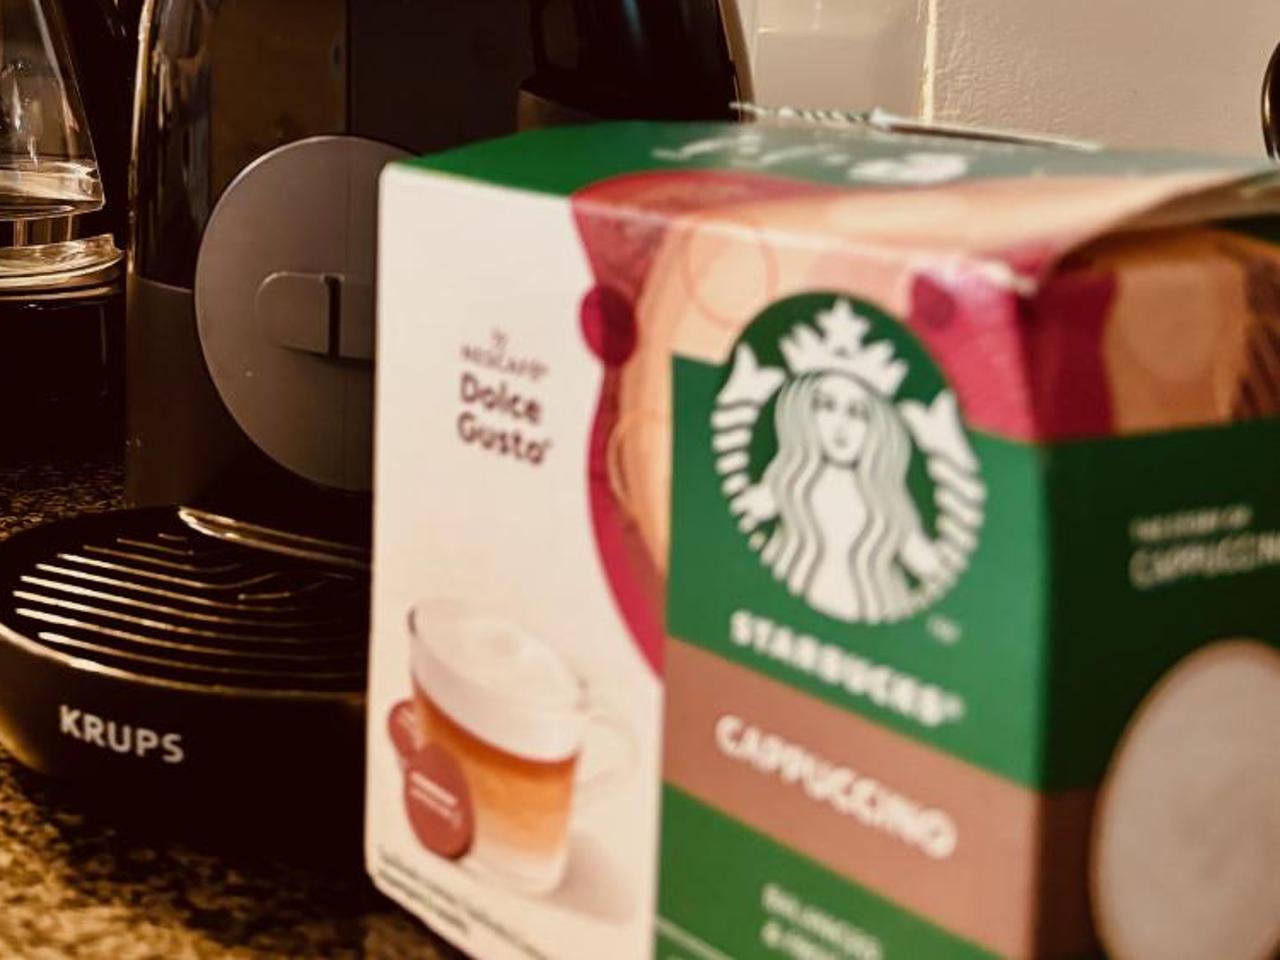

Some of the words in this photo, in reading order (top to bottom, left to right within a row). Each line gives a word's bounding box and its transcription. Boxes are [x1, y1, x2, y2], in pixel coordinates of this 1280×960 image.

[460, 372, 541, 424] Dolce
[60, 704, 184, 763] KRUPS
[715, 714, 957, 859] CAPPUCCINO
